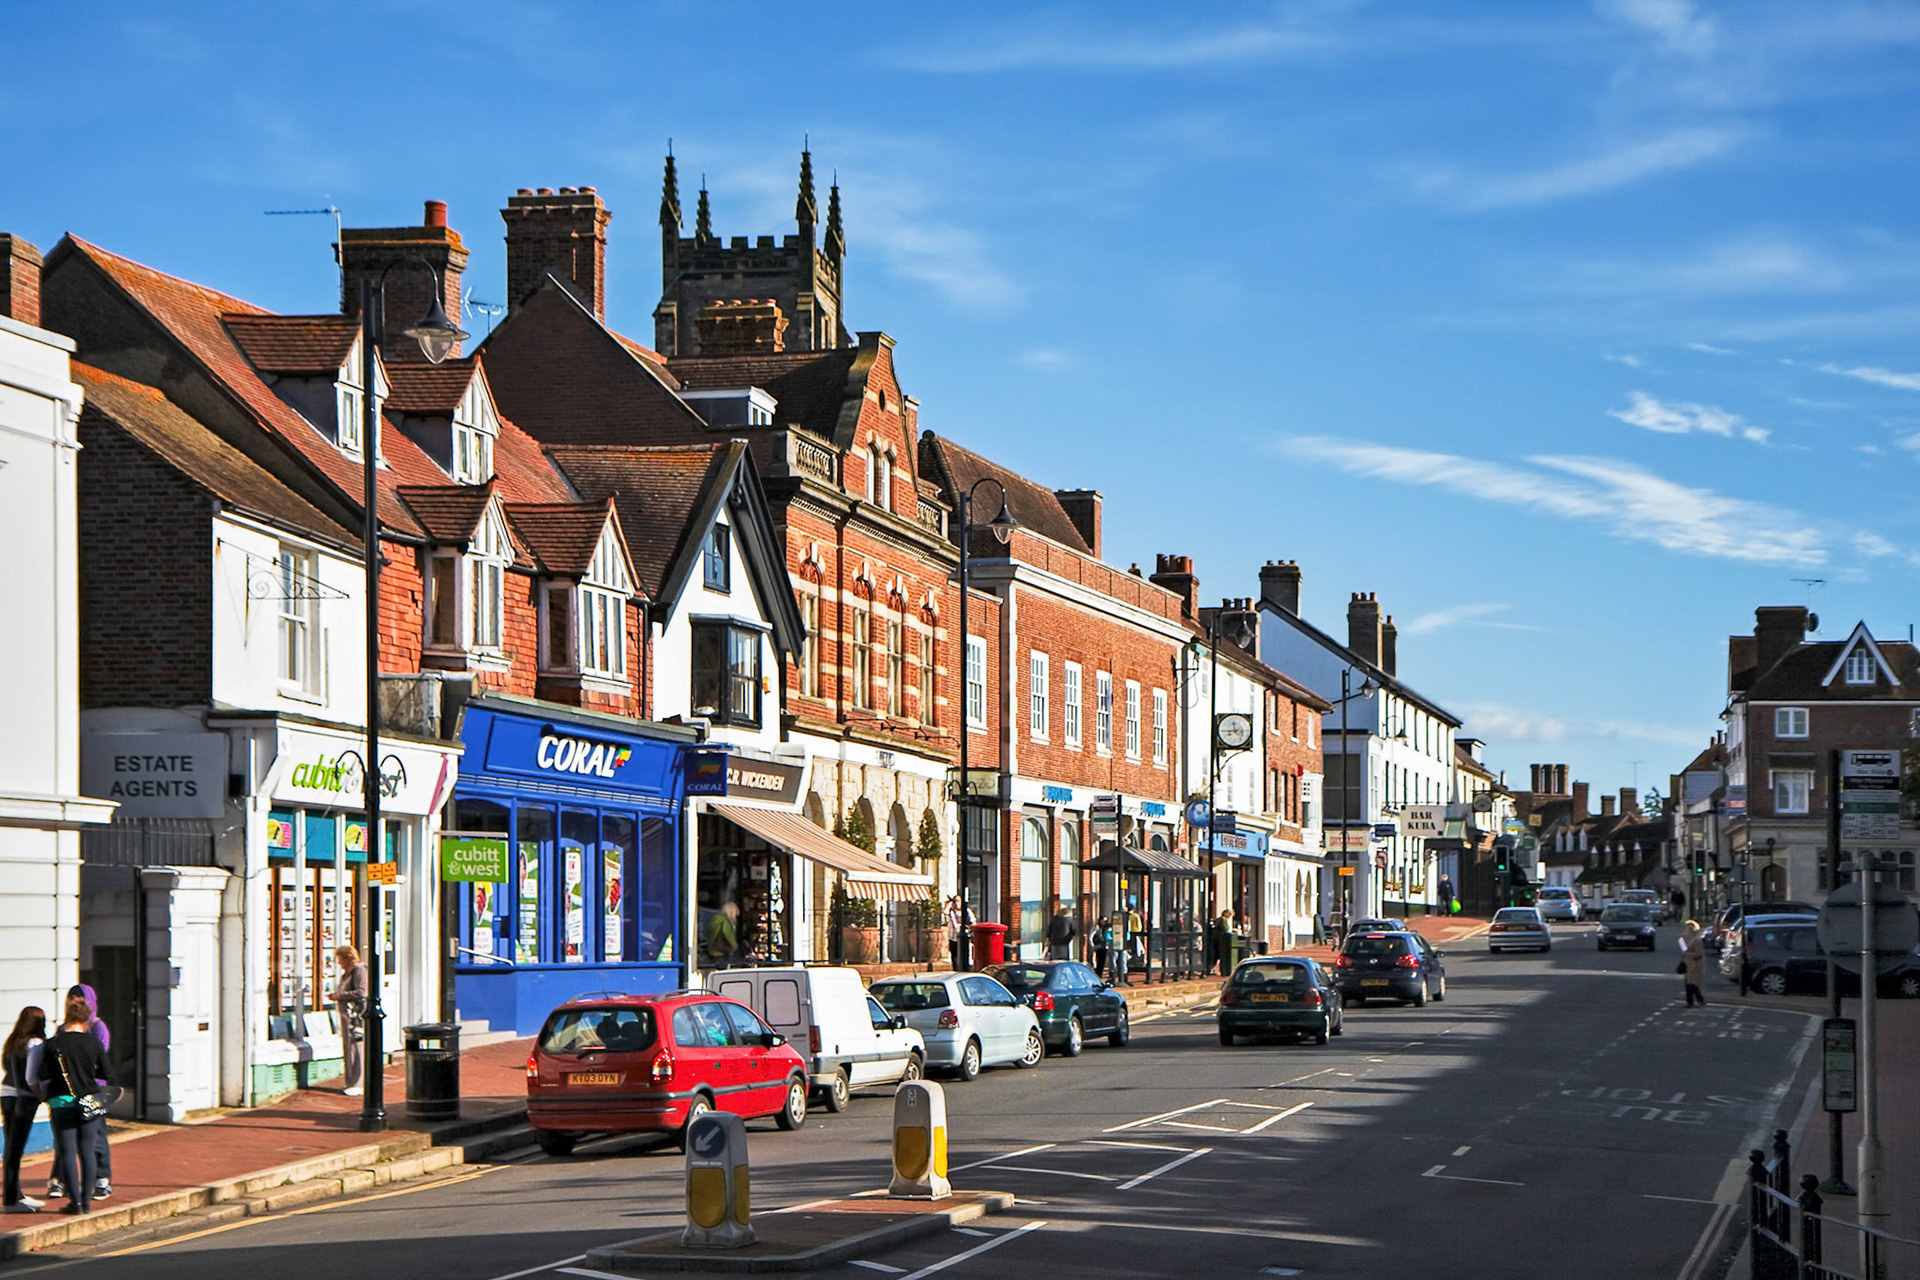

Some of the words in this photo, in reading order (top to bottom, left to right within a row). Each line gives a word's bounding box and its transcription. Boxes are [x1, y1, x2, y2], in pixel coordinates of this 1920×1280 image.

[114, 755, 193, 772] ESTATE
[537, 735, 616, 778] CORAL
[110, 780, 197, 797] AGENTS
[687, 782, 724, 792] CORAL
[1411, 811, 1433, 820] BAR
[1407, 822, 1436, 830] KUBA
[453, 845, 500, 862] cubitt
[462, 862, 501, 877] west
